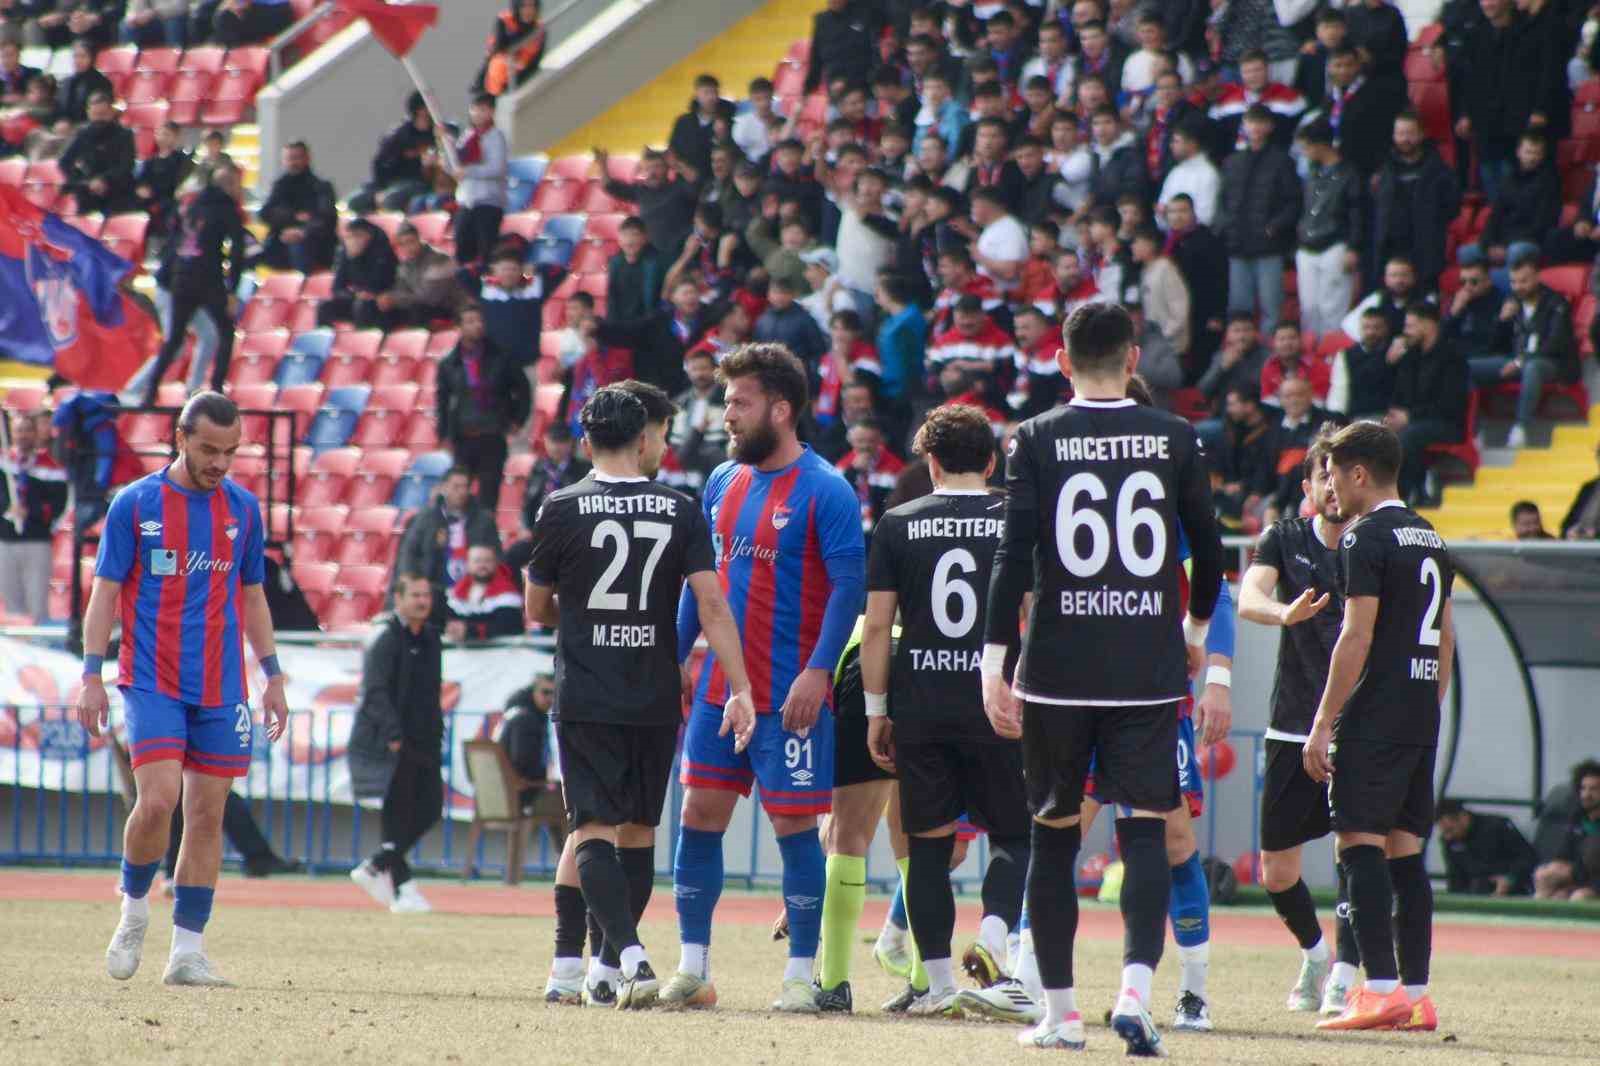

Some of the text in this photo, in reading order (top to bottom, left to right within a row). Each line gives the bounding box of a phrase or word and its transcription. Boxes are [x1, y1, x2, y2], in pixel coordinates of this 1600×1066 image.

[1055, 435, 1170, 461] HACETTEPE
[577, 494, 677, 517] HACETTEPE
[1055, 470, 1167, 578] 66
[586, 519, 672, 611] 27
[931, 548, 977, 638] 6
[1061, 584, 1163, 616] BEKİRCAN
[1418, 556, 1441, 646] 2
[784, 738, 812, 768] 91
